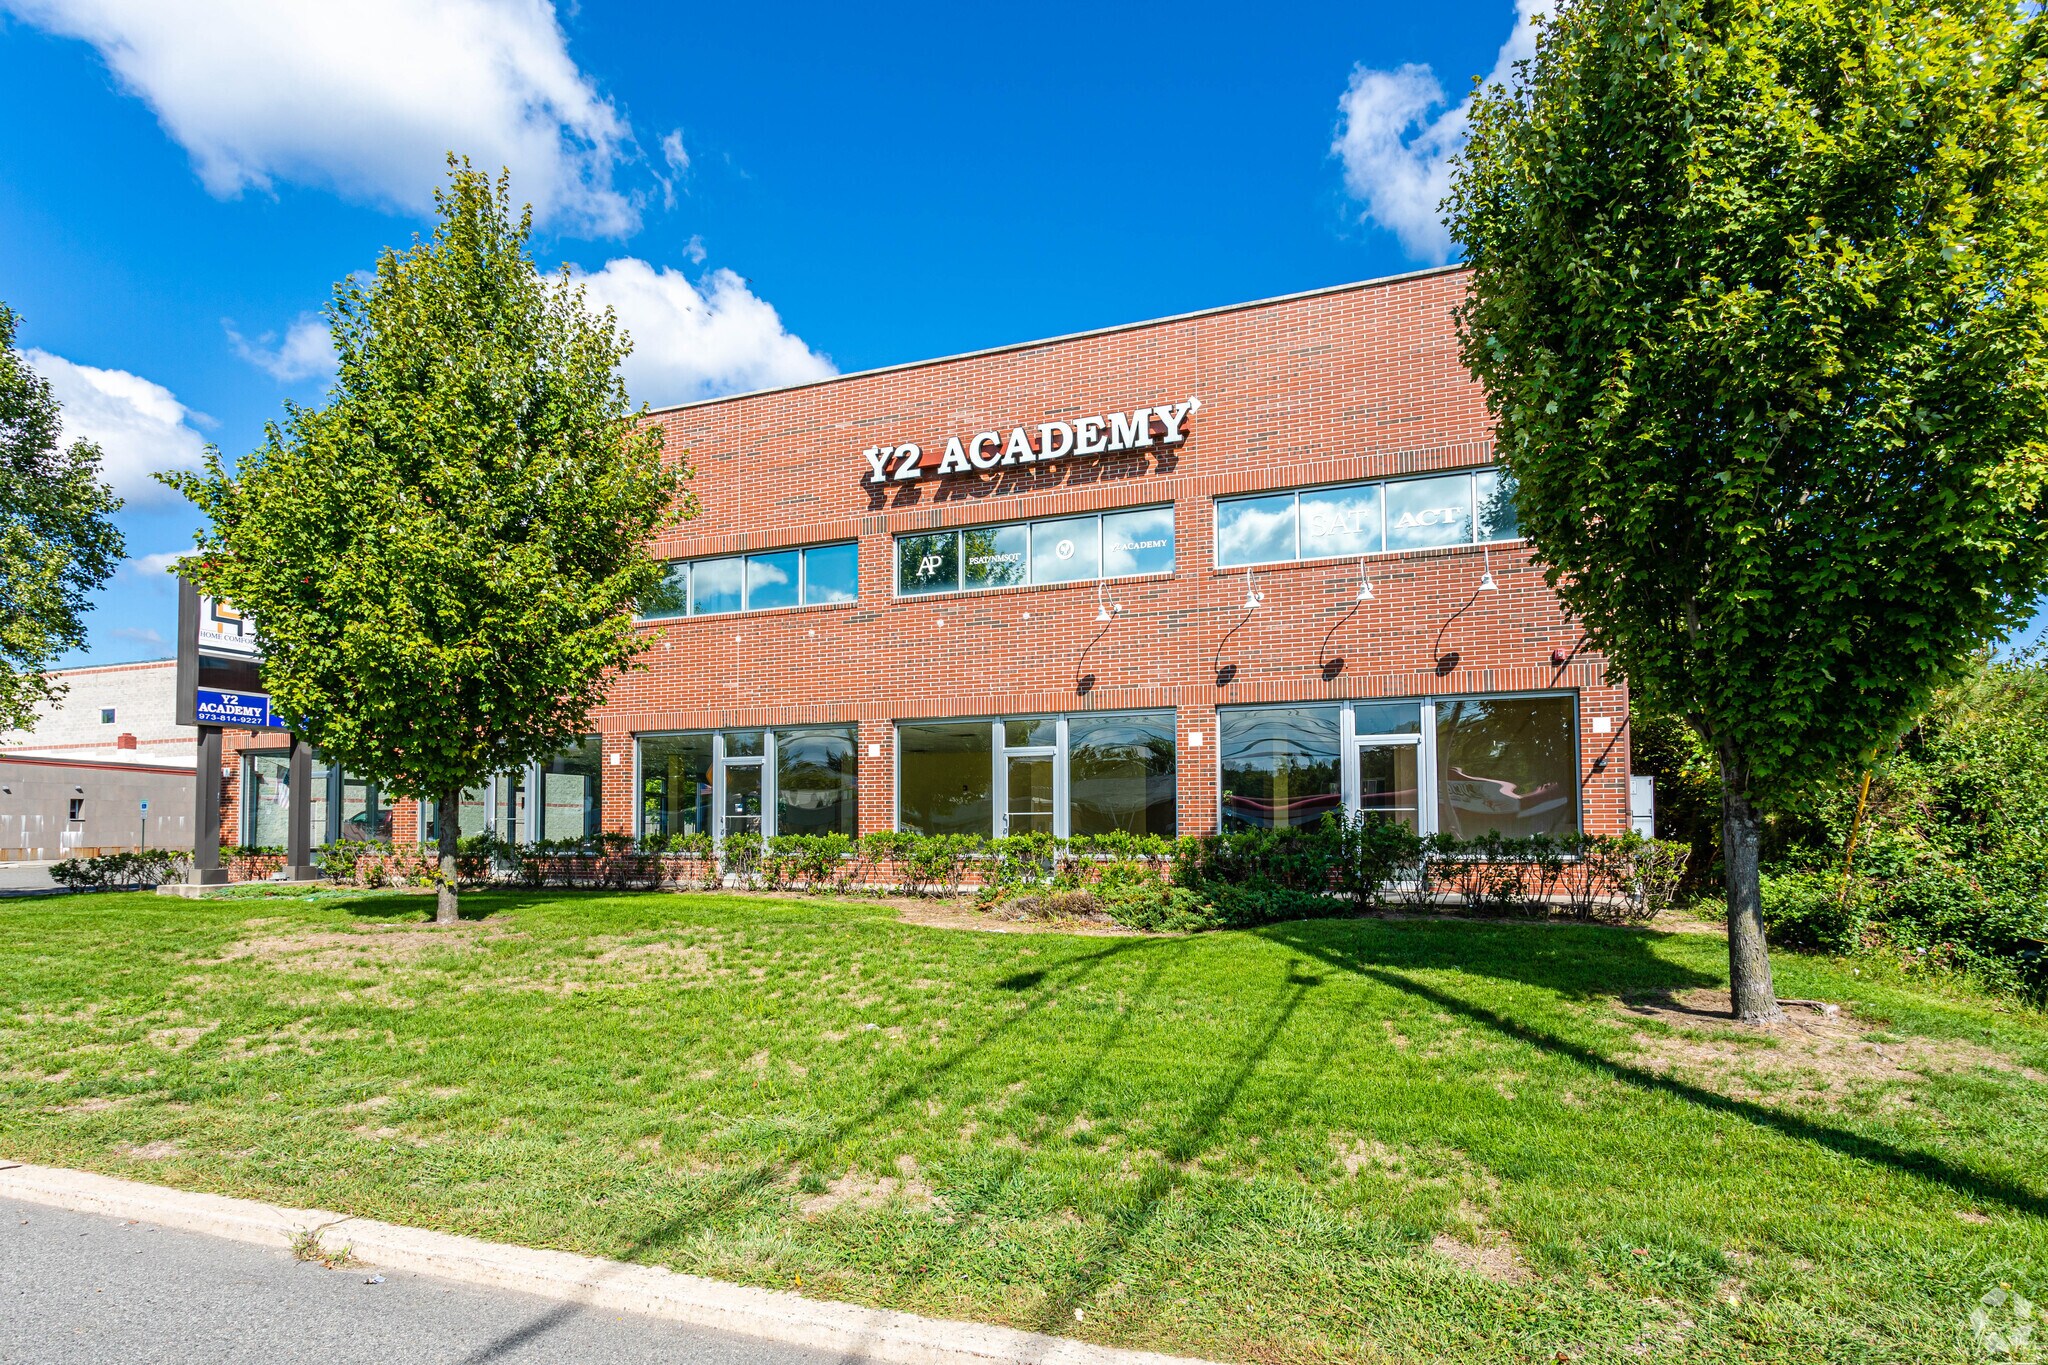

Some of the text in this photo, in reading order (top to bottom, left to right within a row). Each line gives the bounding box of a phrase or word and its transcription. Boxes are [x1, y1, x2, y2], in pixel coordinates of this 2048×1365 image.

[862, 402, 1193, 483] Y2 ACADEMY
[1311, 509, 1367, 538] SAT
[1393, 506, 1461, 529] ACT
[1122, 539, 1168, 553] ACADEMY
[968, 552, 1021, 565] PSAT/NMSQT
[915, 555, 942, 577] AP
[200, 630, 223, 640] HOME
[220, 694, 239, 705] Y2
[198, 702, 263, 717] ACADEMY
[198, 713, 262, 724] 973-814-9227
